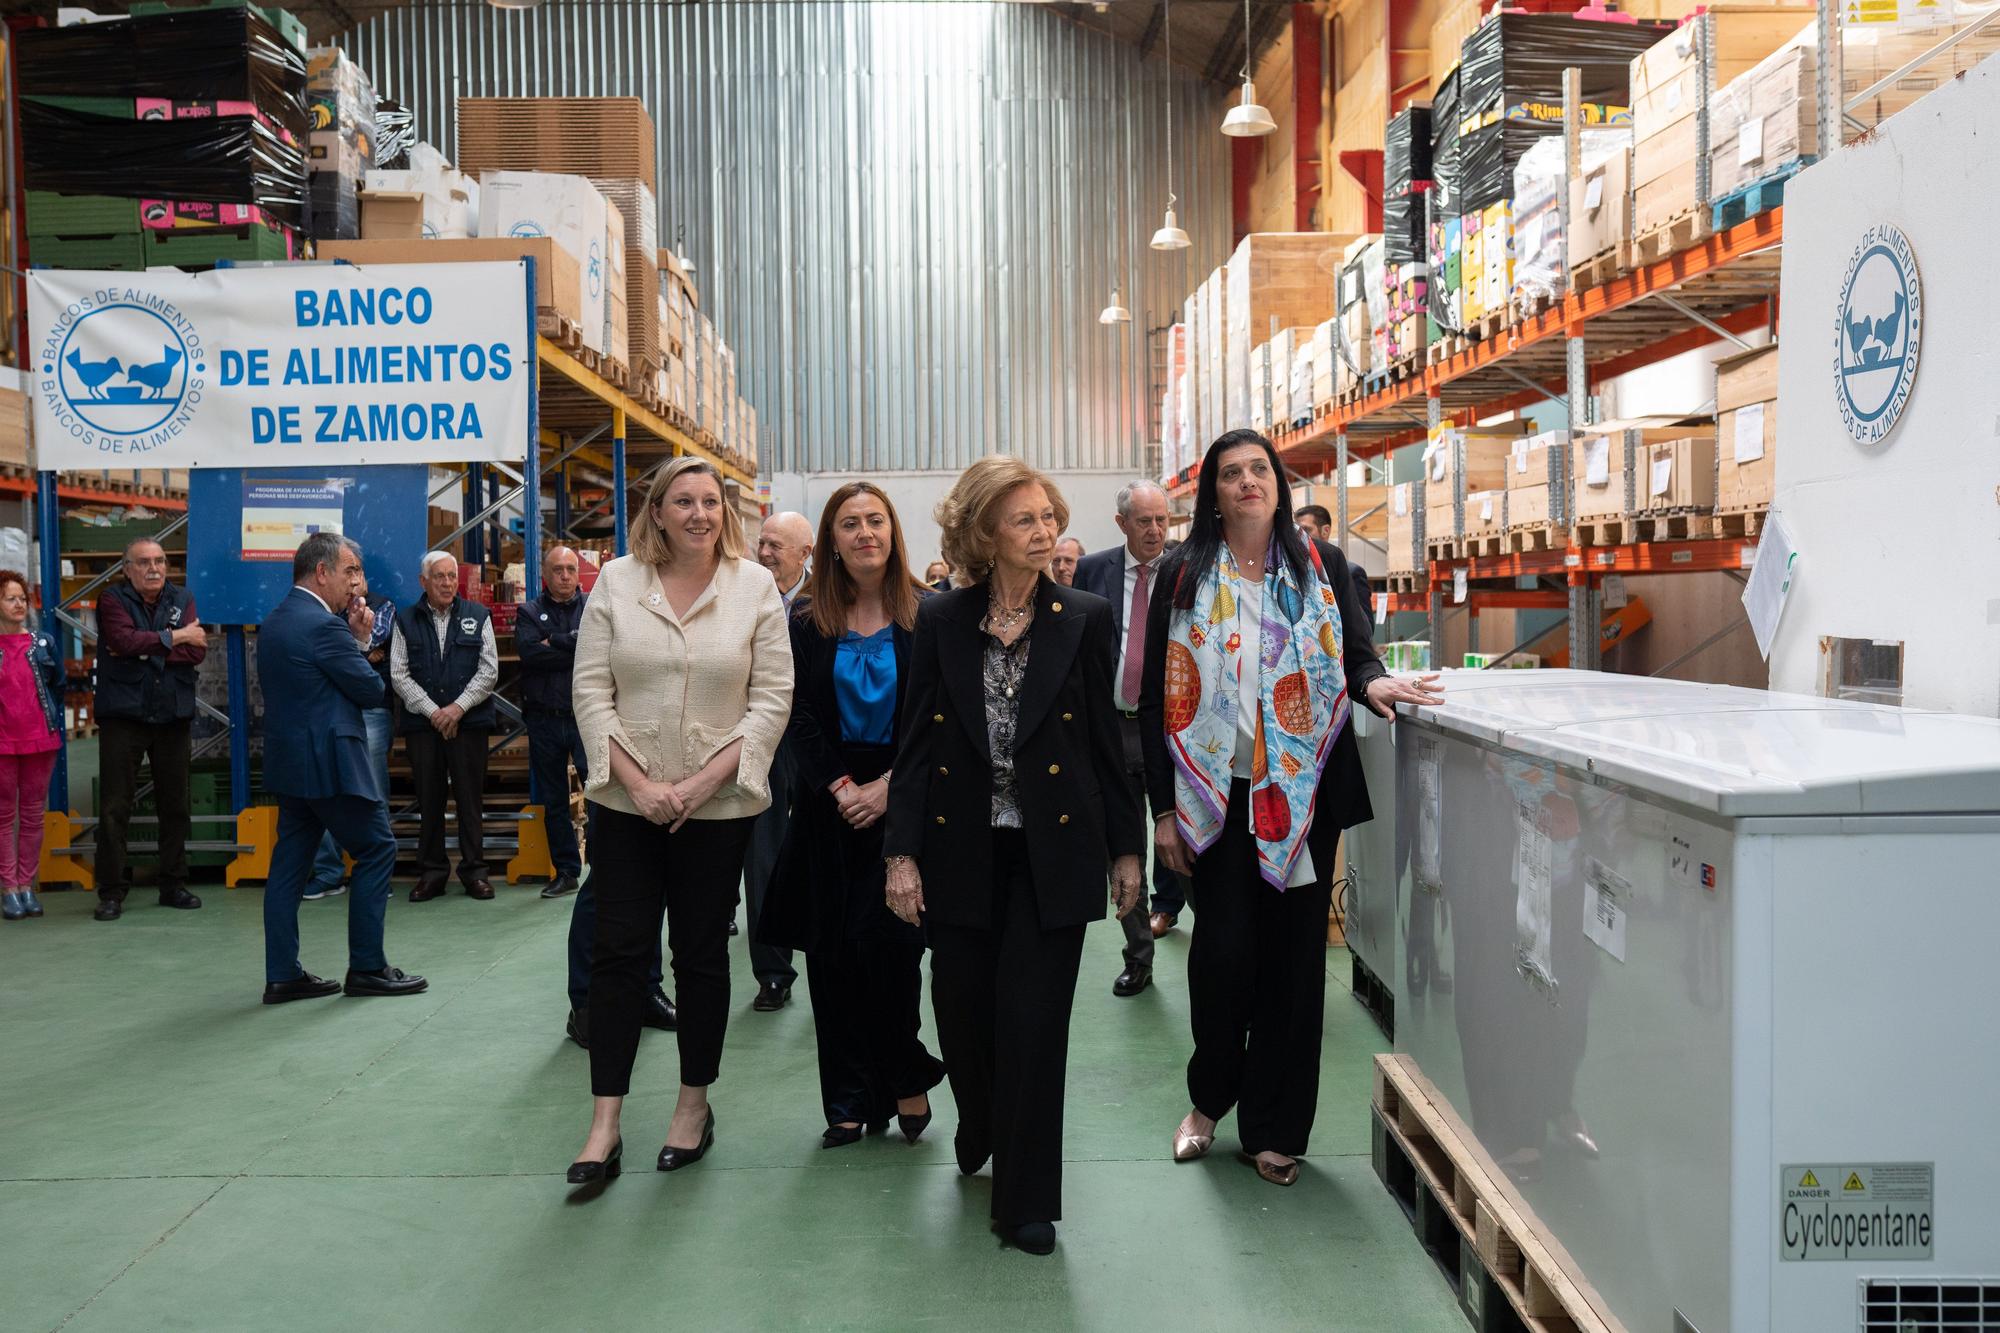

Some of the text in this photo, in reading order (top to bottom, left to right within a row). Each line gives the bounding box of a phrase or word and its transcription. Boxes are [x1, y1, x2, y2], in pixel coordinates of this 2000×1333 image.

[1834, 224, 1919, 331] BANCOS DE ALIMENTOS
[42, 288, 204, 360] BANCOS DE ALIMENTOS
[295, 287, 432, 327] BANCO
[220, 343, 512, 386] DE ALIMENTOS
[1833, 358, 1855, 432] BANCOS
[1870, 340, 1918, 442] ALIMENTOS
[41, 377, 204, 453] BANCOS DE ALIMENTOS
[251, 402, 483, 444] DE ZAMORA
[1788, 1190, 1831, 1198] DANGER
[1784, 1202, 1931, 1260] Cyclopentane
